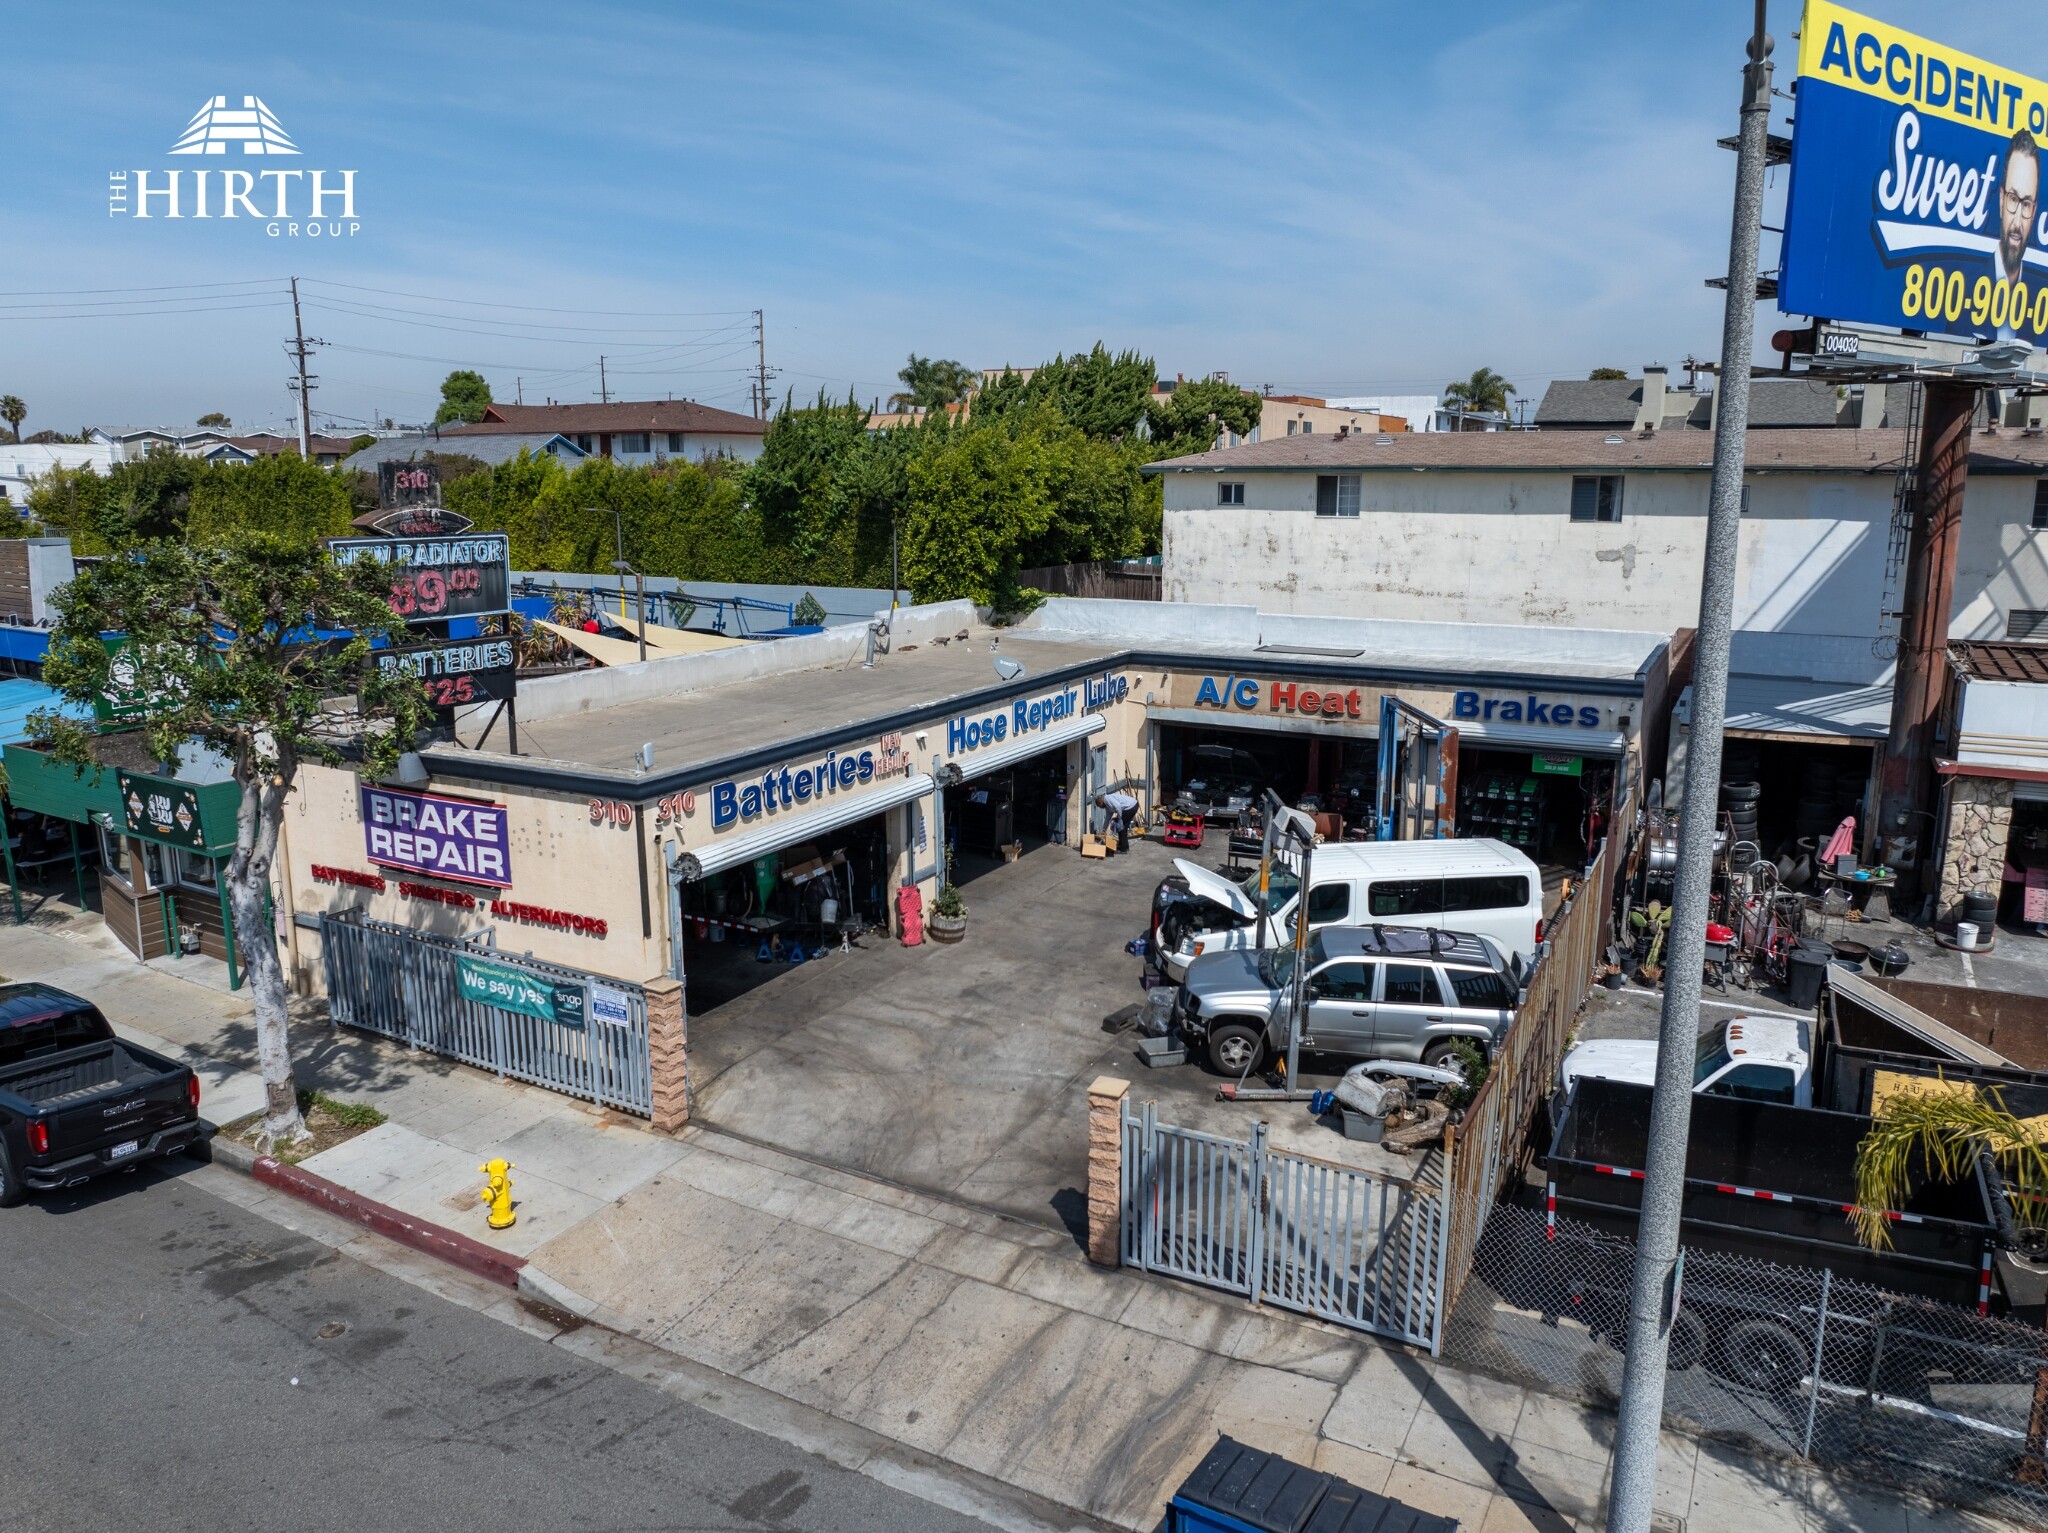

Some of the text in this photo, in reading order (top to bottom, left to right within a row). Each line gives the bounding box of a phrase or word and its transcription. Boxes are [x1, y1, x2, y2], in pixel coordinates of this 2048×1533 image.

[1819, 20, 2048, 138] ACCIDENT O
[1878, 110, 1998, 230] Sweet
[1826, 335, 1859, 353] 004032
[395, 470, 429, 489] 310
[396, 540, 504, 567] RADIATOR
[378, 640, 514, 681] BATTERIES
[424, 675, 475, 705] $25
[1196, 675, 1362, 716] A/C Heat
[947, 672, 1129, 755] Hose Repair Lube
[1454, 689, 1600, 727] Brakes
[880, 731, 902, 751] NEW
[874, 751, 910, 776] REBUILT
[710, 750, 874, 828] Batteries
[370, 793, 499, 843] BRAKE
[588, 798, 633, 826] 310
[657, 791, 696, 820] 310
[369, 826, 504, 878] REPAIR
[311, 864, 386, 891] BATTERIES
[399, 881, 476, 910] STARTERS
[490, 899, 608, 935] ALTERNATORS
[462, 968, 486, 990] We
[489, 980, 515, 1000] say
[557, 993, 583, 1008] snap
[103, 1098, 147, 1117] GMC
